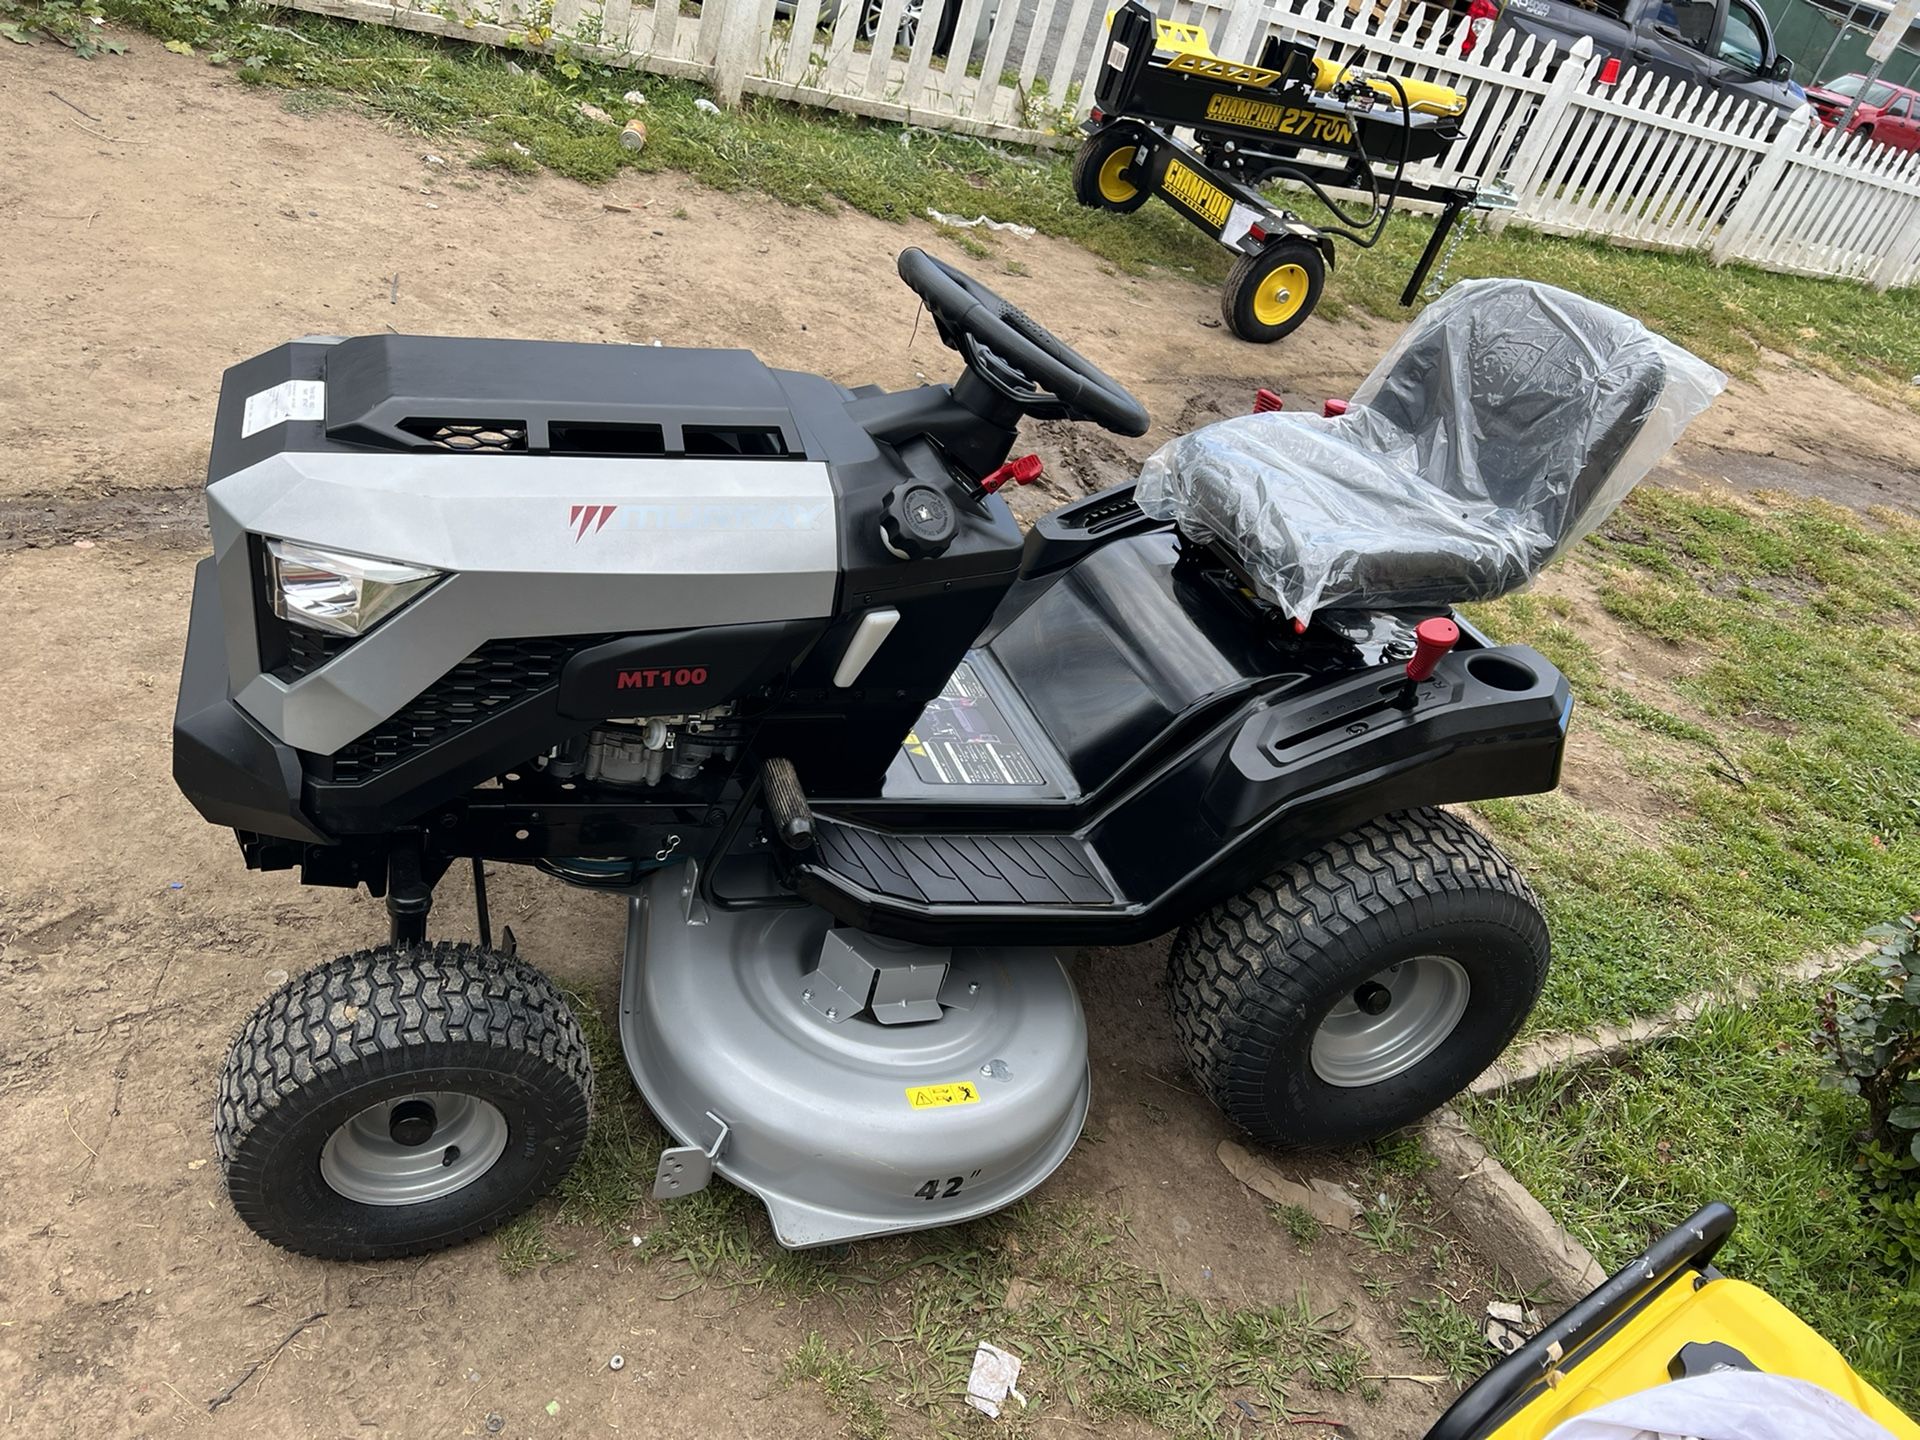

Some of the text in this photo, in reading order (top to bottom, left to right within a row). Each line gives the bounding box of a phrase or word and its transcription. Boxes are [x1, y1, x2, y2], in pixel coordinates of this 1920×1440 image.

[1208, 95, 1353, 144] CHAMPION 27 TON
[1166, 161, 1232, 223] CHAMPION
[617, 667, 707, 689] MT100
